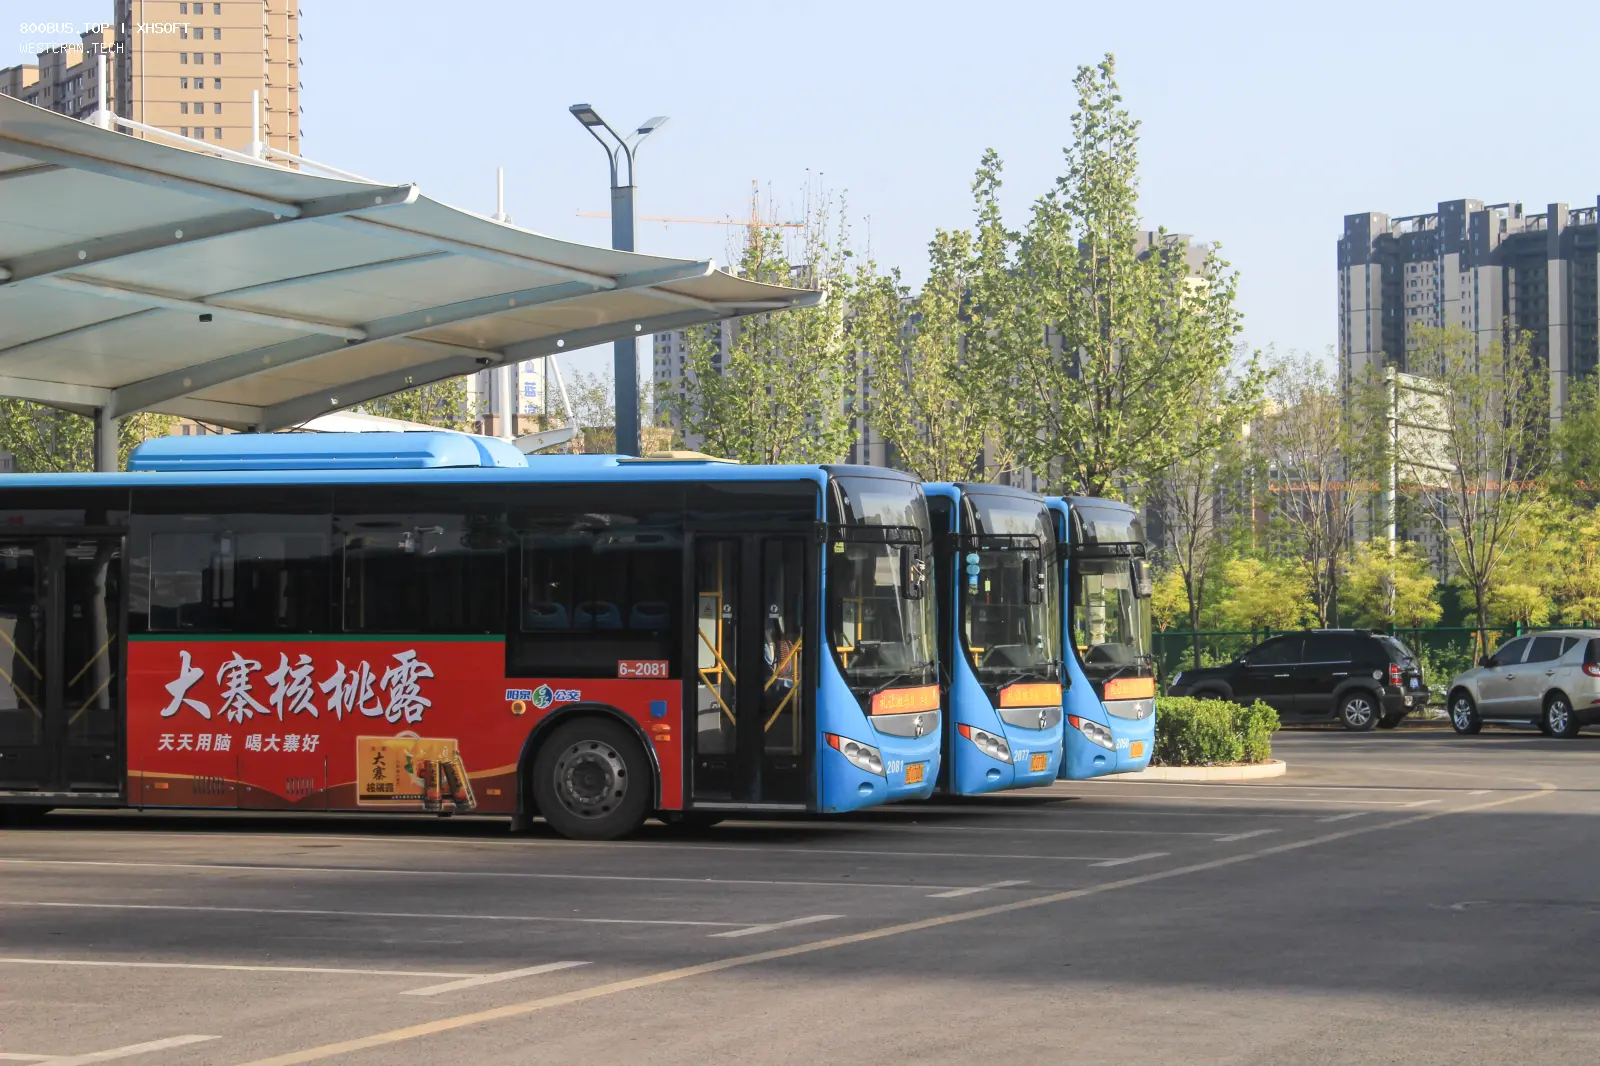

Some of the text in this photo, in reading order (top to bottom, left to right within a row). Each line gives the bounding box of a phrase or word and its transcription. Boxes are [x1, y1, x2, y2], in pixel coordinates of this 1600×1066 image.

[619, 662, 667, 676] 6-2081
[160, 649, 434, 724] 大寨核桃露
[506, 689, 532, 701] 阳泉
[554, 689, 581, 701] 公交
[158, 733, 320, 753] 天天用脑 喝大寨好
[886, 760, 904, 774] 2081
